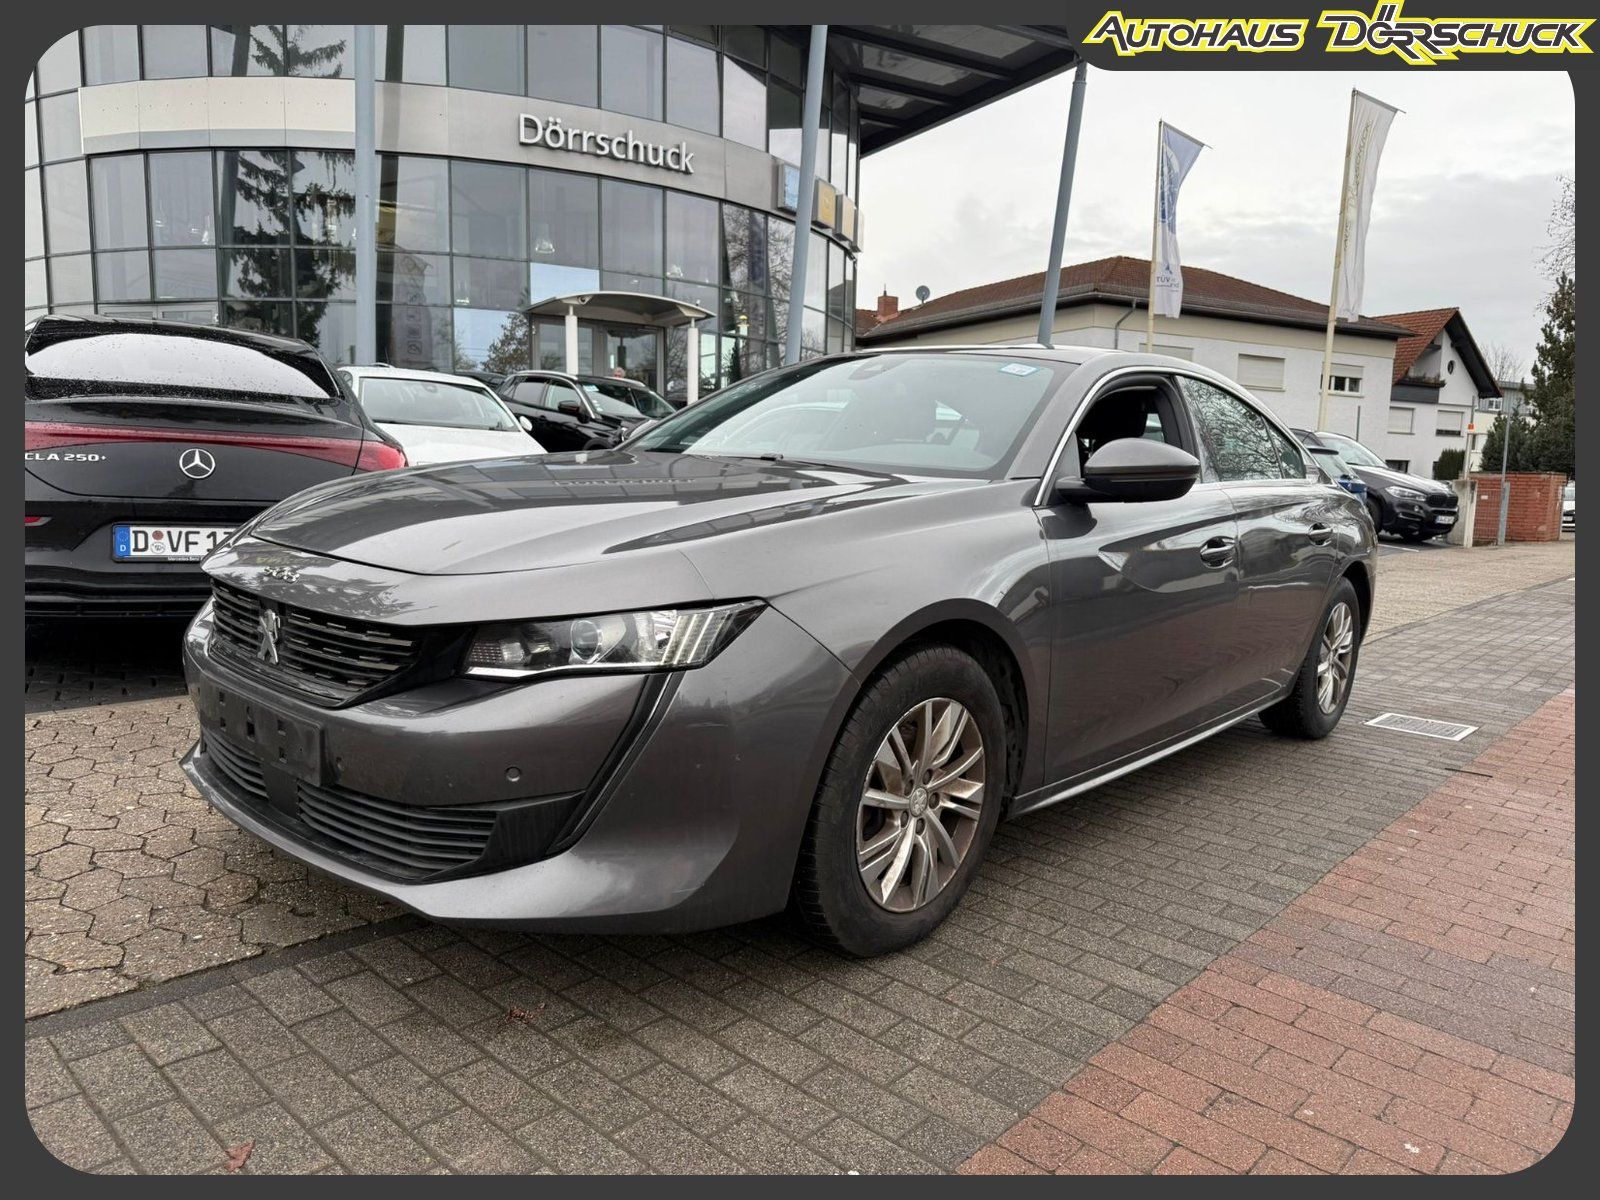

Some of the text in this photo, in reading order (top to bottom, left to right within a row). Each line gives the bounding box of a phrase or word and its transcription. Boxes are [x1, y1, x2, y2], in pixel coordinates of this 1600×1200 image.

[518, 113, 695, 174] Dörrschuck
[24, 452, 107, 462] CLA 250+
[120, 543, 127, 552] D
